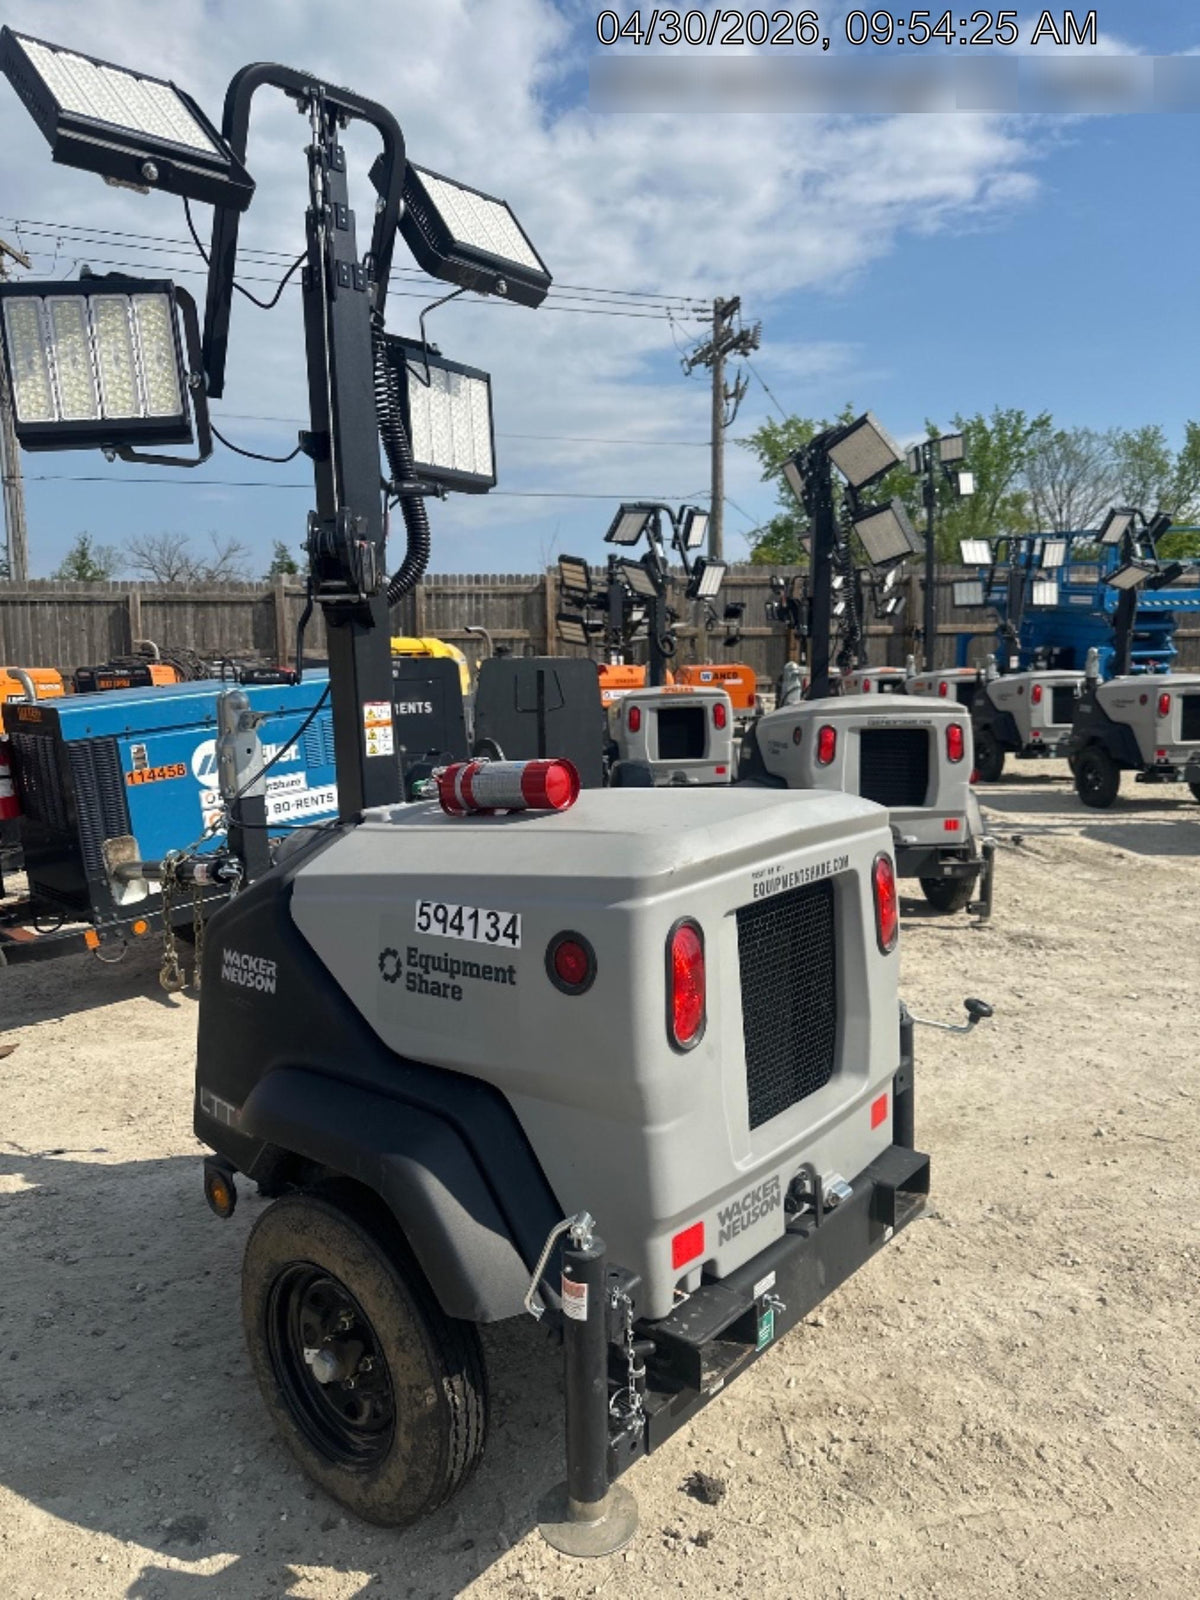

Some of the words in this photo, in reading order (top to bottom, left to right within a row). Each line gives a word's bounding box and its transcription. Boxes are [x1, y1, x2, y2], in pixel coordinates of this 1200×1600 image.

[417, 902, 520, 946] 594134
[221, 964, 277, 994] NEUSON
[223, 948, 277, 976] WACKER
[407, 947, 516, 985] Equipment
[406, 972, 462, 1001] Share
[717, 1175, 780, 1227] WACKER
[718, 1191, 781, 1247] NEUSON
